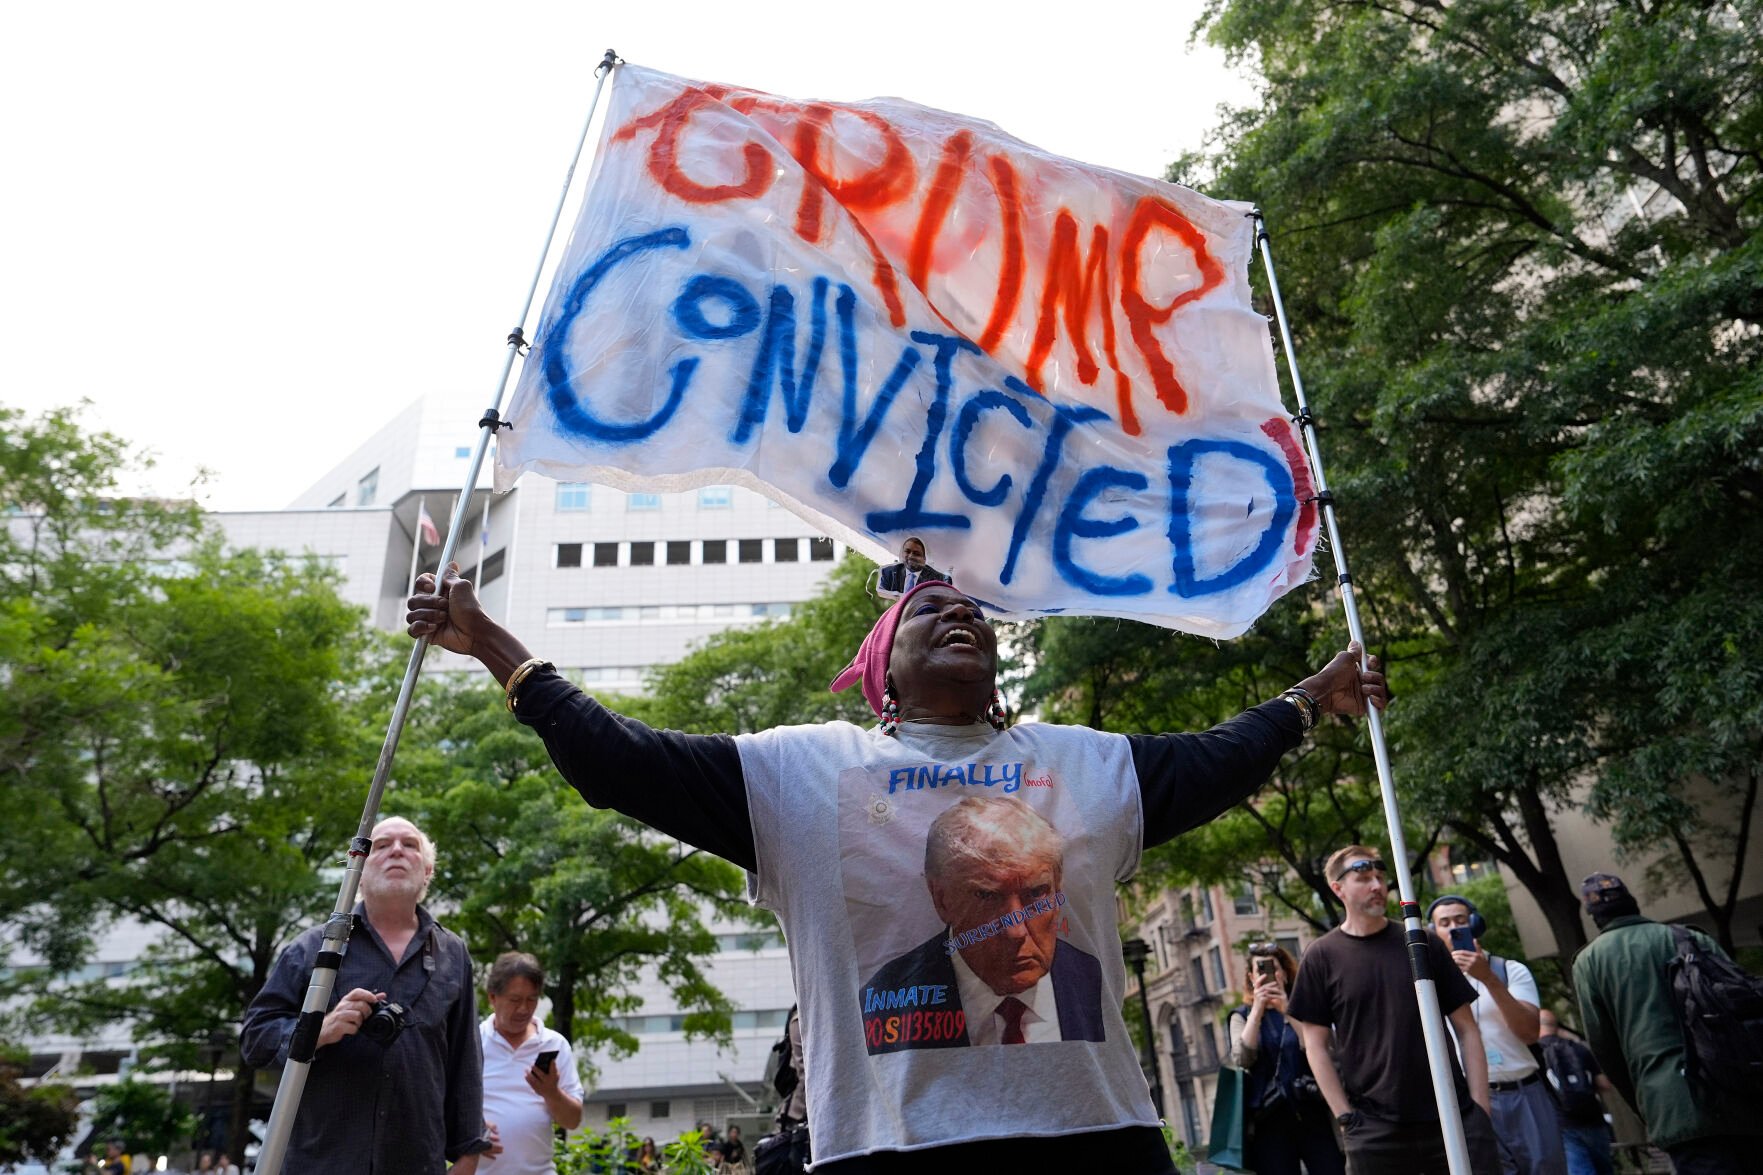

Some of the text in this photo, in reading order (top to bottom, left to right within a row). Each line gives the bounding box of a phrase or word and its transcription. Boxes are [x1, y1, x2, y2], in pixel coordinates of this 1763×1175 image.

[888, 763, 1024, 794] FINALLY
[943, 891, 1066, 956] SURRENDERED
[864, 984, 948, 1014] INMATE
